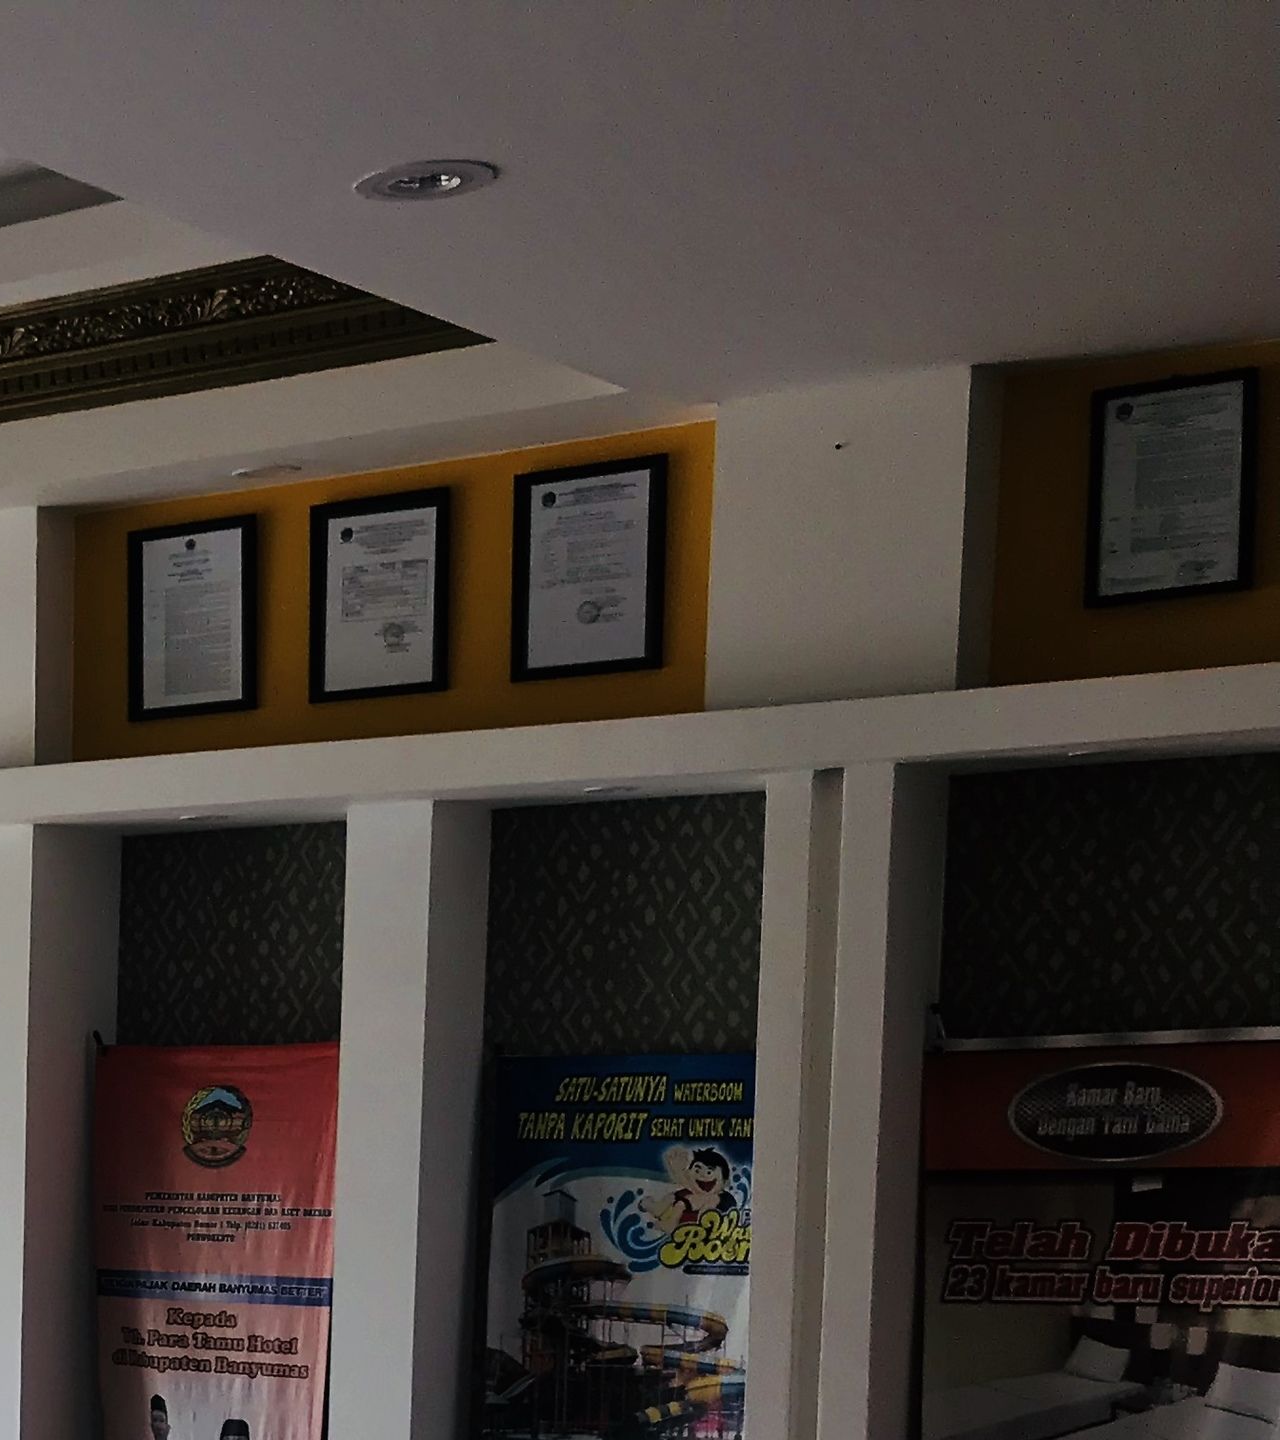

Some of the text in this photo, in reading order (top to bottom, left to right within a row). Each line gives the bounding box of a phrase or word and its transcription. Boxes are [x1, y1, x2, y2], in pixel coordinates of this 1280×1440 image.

[554, 1075, 744, 1103] SATU-SATUNYA WATERBOOM
[516, 1111, 566, 1140] TANPA
[571, 1111, 650, 1140] KAPORIT
[650, 1117, 686, 1138] SEHAT
[688, 1117, 726, 1138] UNTUK
[947, 1221, 1280, 1262] Telah Dibuka
[170, 1282, 217, 1293] DAERAH
[218, 1283, 278, 1296] BANYUMAS
[943, 1264, 989, 1301] 23
[991, 1265, 1089, 1302] kamar
[1093, 1266, 1165, 1303] baru
[165, 1307, 237, 1329] Kepada
[147, 1329, 189, 1348] Para
[192, 1332, 245, 1352] Tamu
[246, 1335, 298, 1355] Hotel
[128, 1349, 212, 1373] Kabupaten
[215, 1356, 310, 1379] Banyumas
